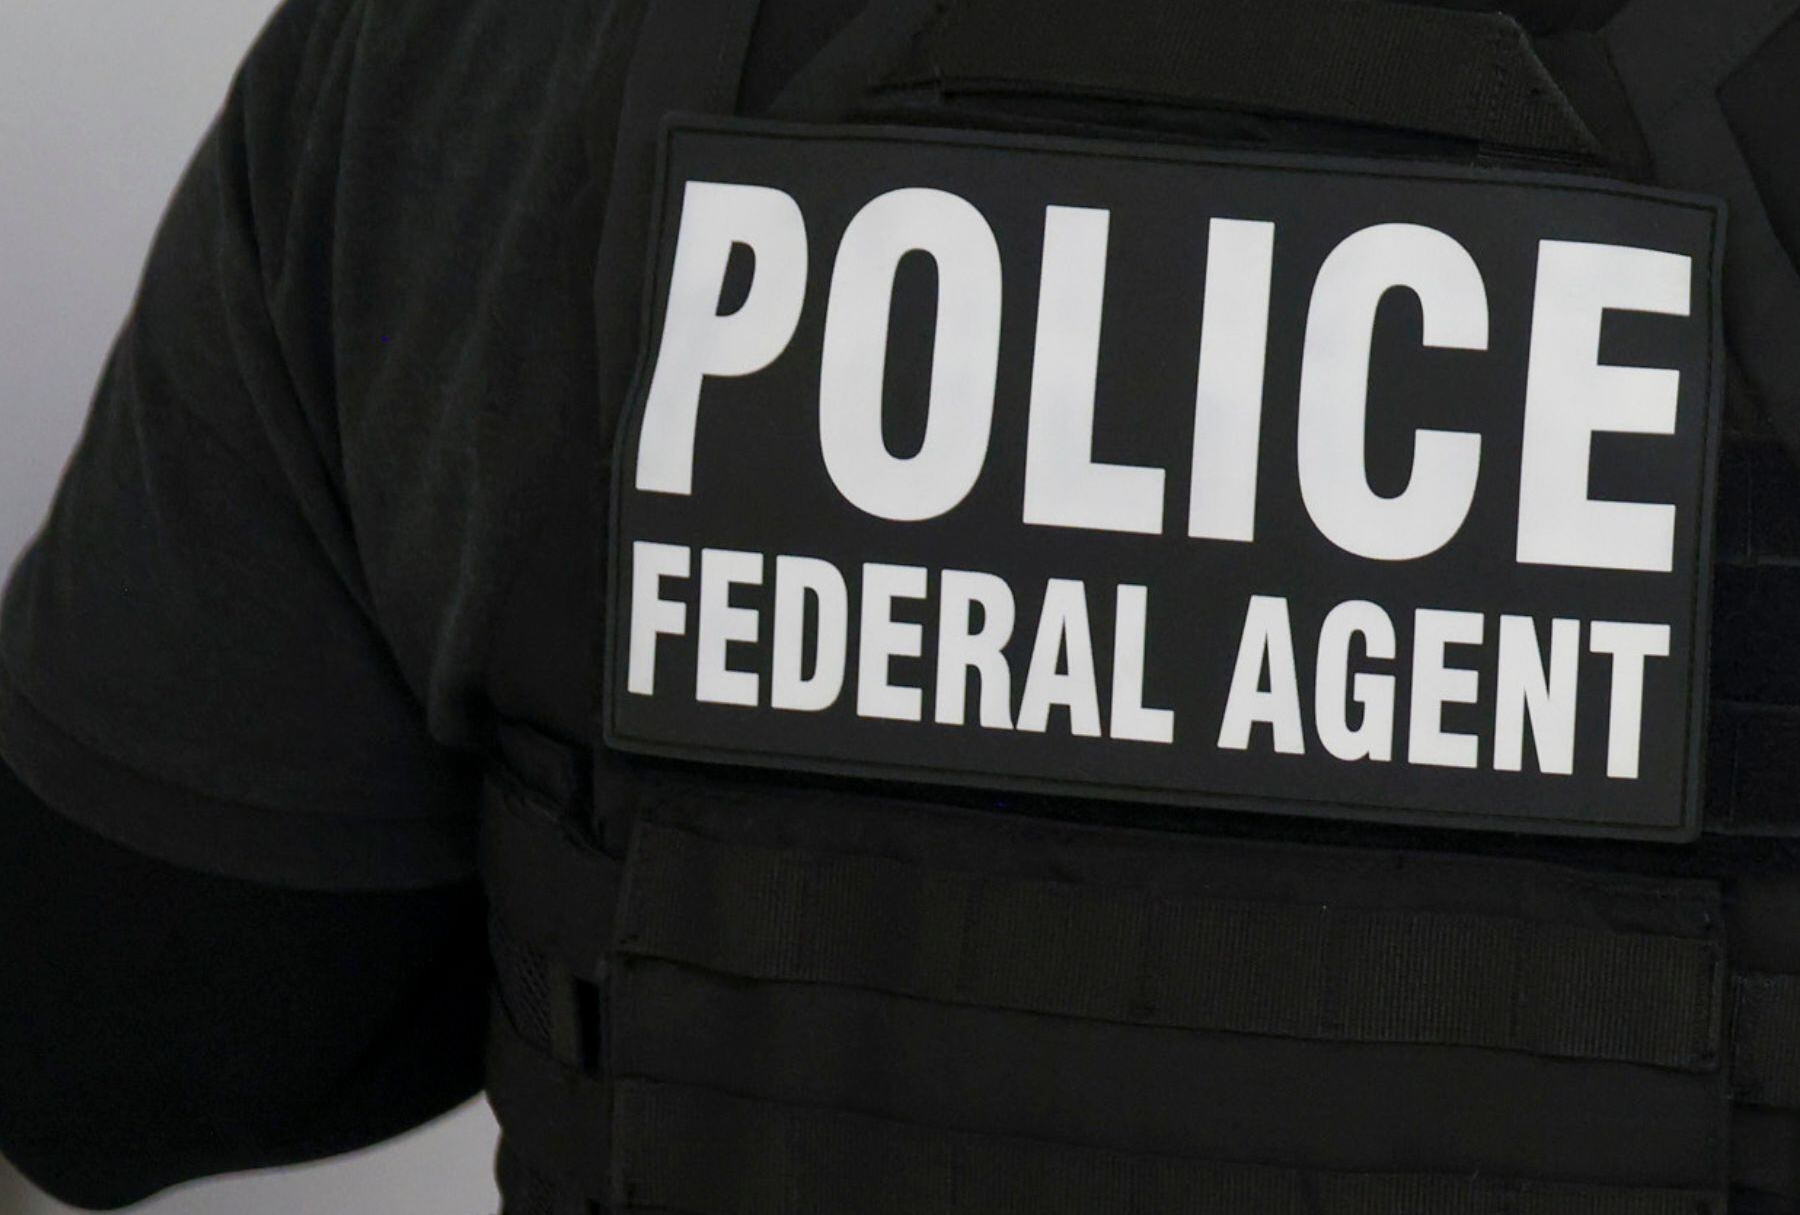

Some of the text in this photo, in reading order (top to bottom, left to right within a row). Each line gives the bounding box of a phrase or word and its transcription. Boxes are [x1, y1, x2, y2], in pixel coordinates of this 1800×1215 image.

[635, 180, 1692, 572] POLICE
[627, 541, 1671, 779] FEDERAL AGENT
